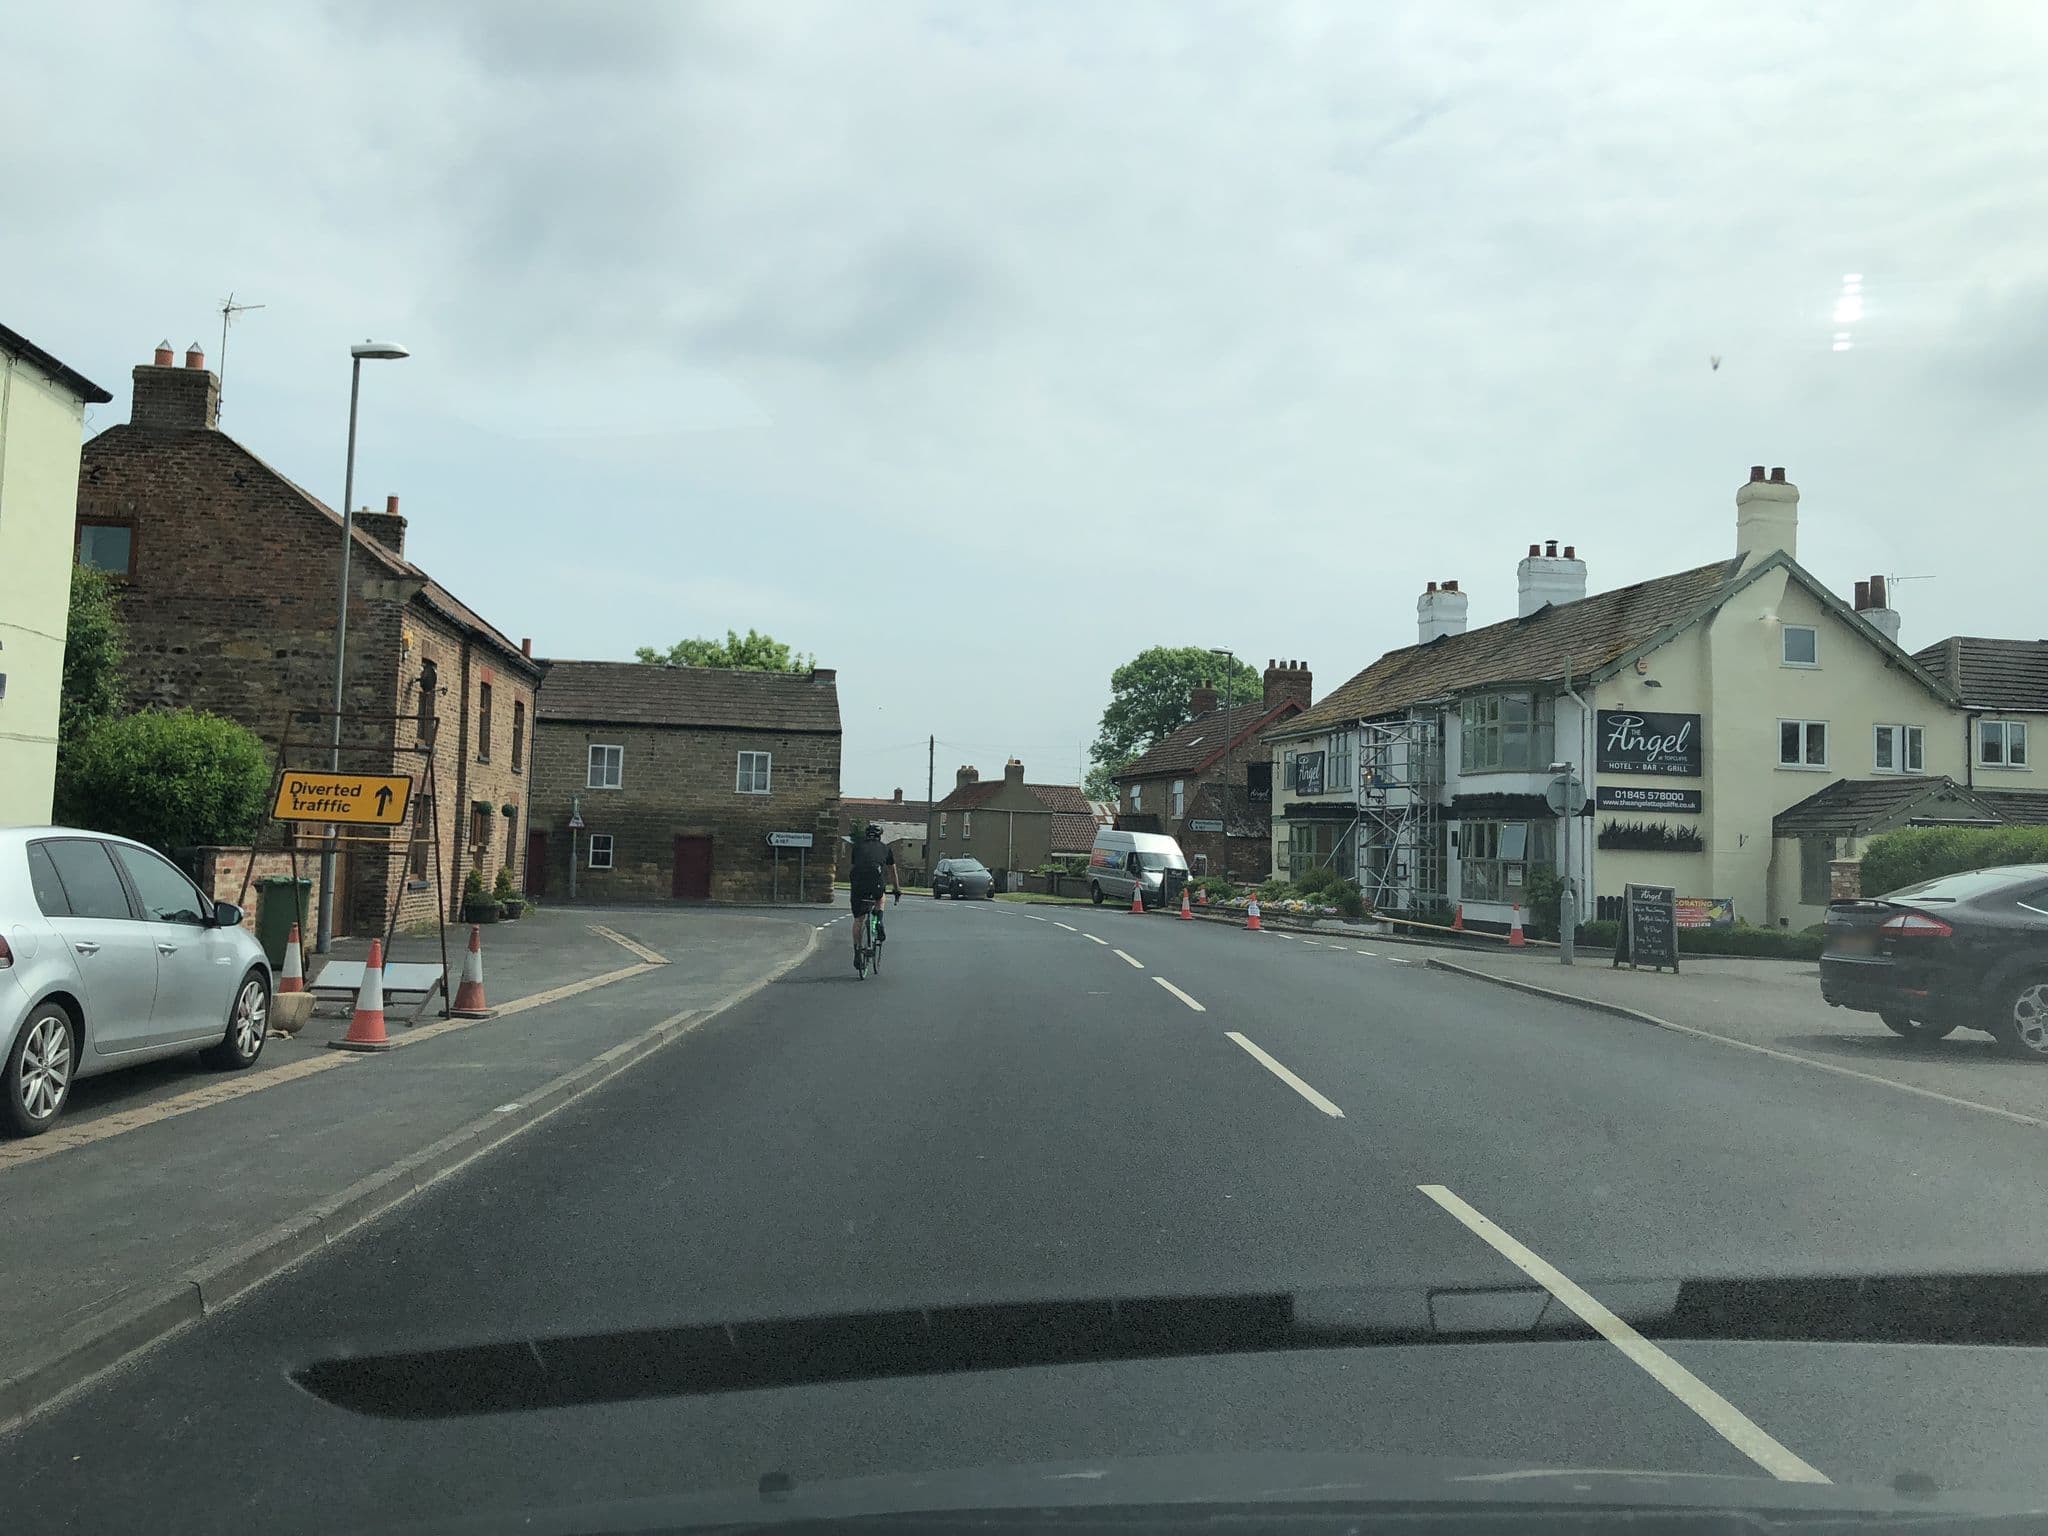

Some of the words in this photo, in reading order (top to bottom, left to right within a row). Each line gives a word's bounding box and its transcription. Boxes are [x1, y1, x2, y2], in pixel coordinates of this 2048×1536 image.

[1607, 717, 1691, 762] Angel
[1299, 756, 1321, 787] Angel
[1609, 762, 1632, 770] HOTEL
[1642, 763, 1657, 771] BAR
[1667, 764, 1688, 773] GRILL
[289, 781, 362, 797] Diverted
[1615, 790, 1646, 800] 01845
[1647, 791, 1684, 800] 578000
[1640, 889, 1663, 901] Angel
